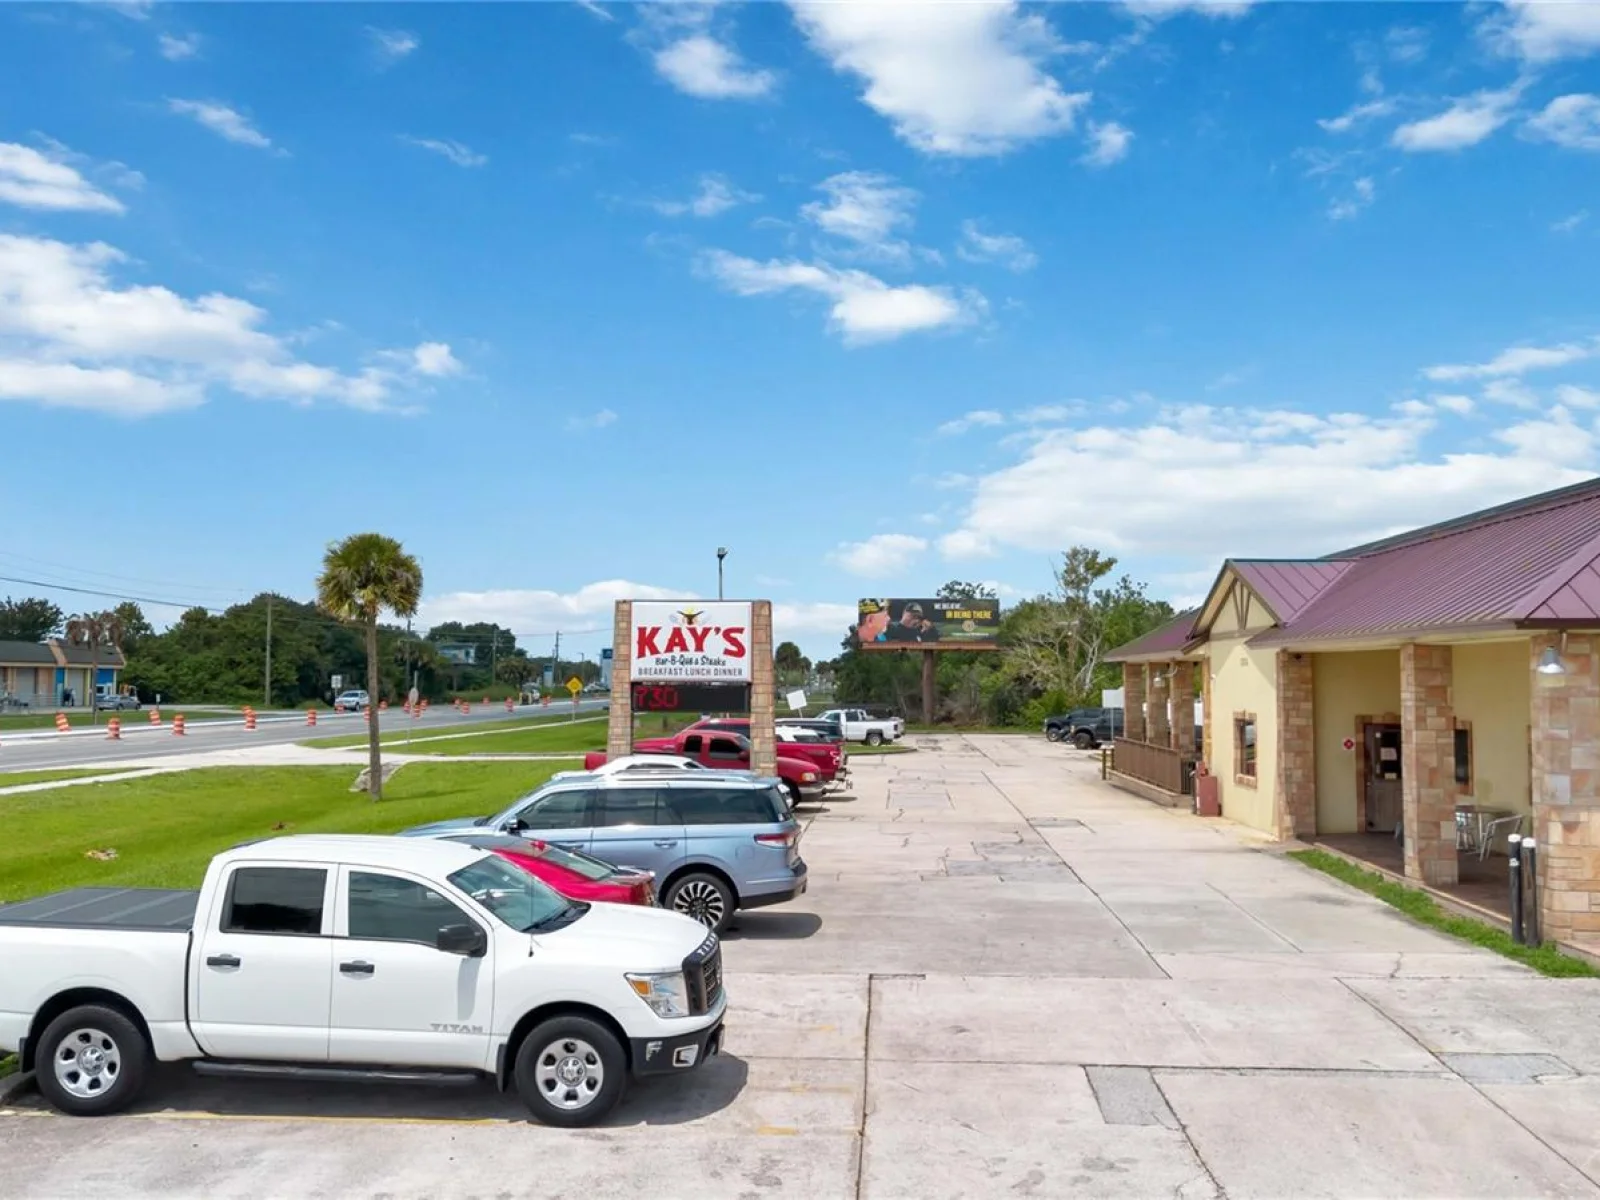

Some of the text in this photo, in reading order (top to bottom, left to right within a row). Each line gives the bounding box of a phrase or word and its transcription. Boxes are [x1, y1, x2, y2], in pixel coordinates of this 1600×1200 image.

[637, 626, 746, 659] KAY'S
[638, 667, 742, 676] BREAKFAST LUNCH DINNER
[430, 1023, 483, 1034] TITAN
